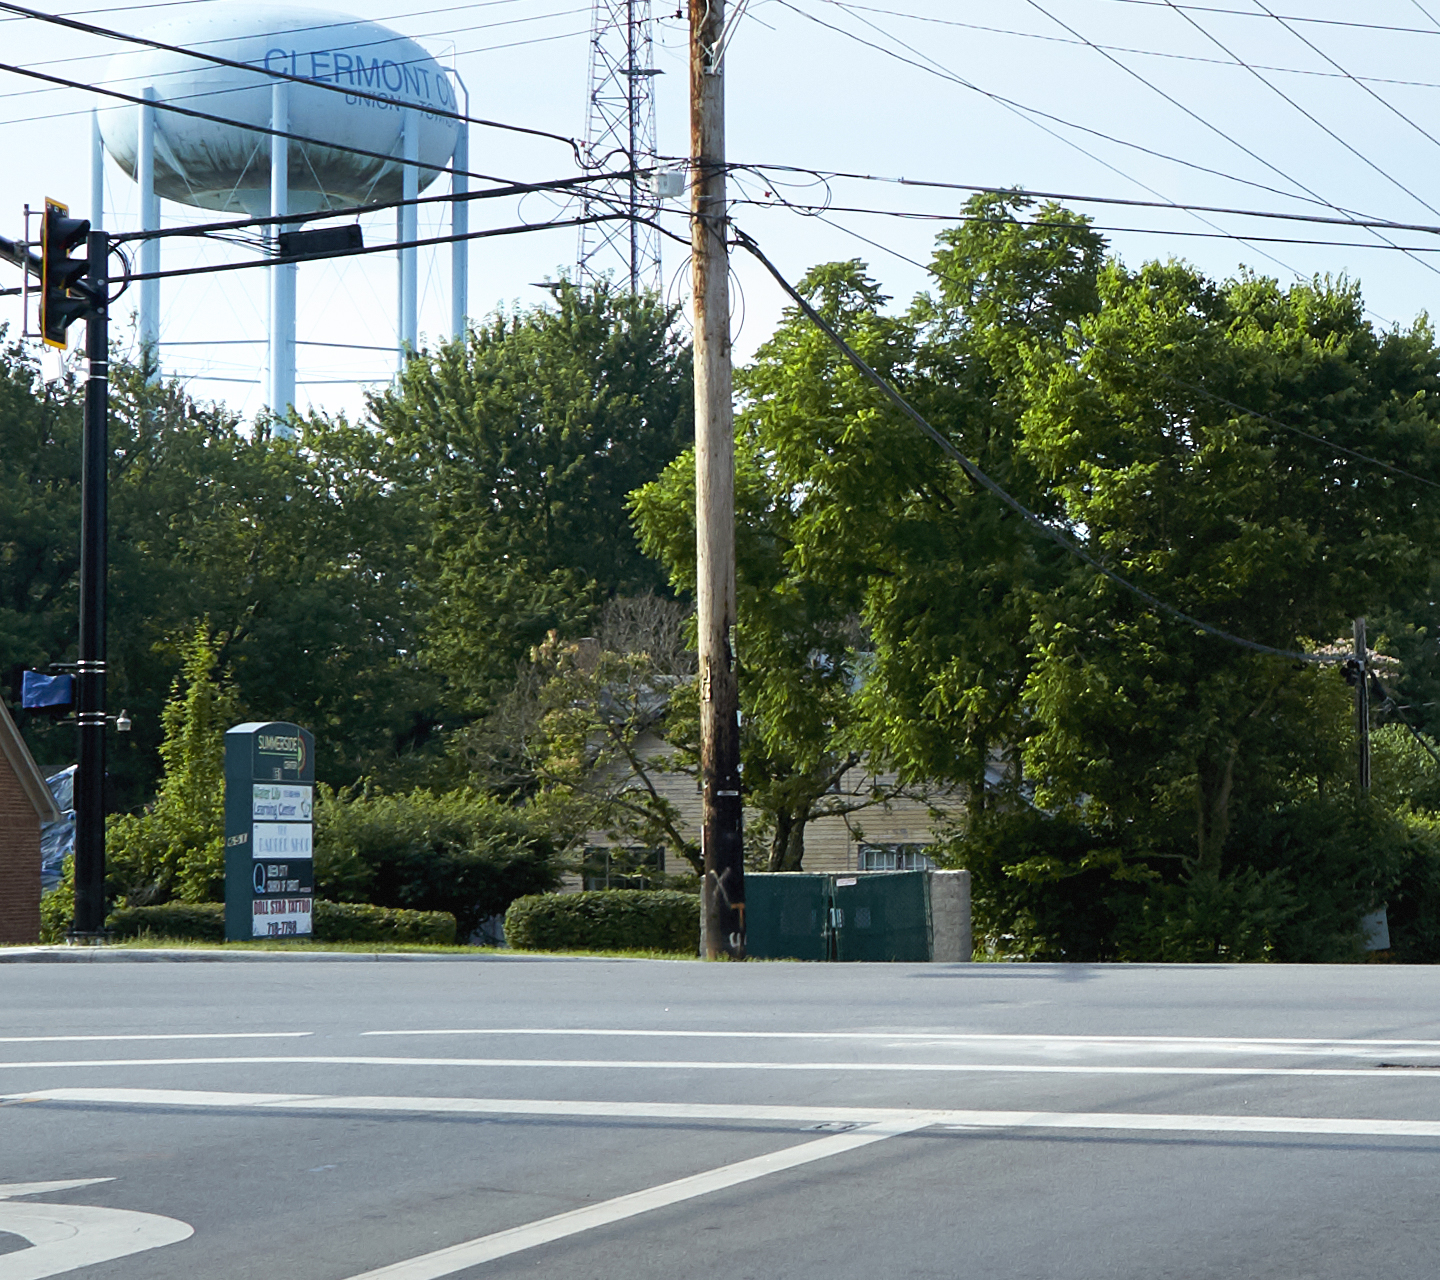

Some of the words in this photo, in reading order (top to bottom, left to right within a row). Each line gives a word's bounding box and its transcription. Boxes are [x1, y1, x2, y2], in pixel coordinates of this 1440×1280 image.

[264, 48, 431, 99] CLERMONT
[253, 900, 268, 915] DOLL
[270, 899, 286, 915] STAR
[287, 898, 311, 914] TATTOO
